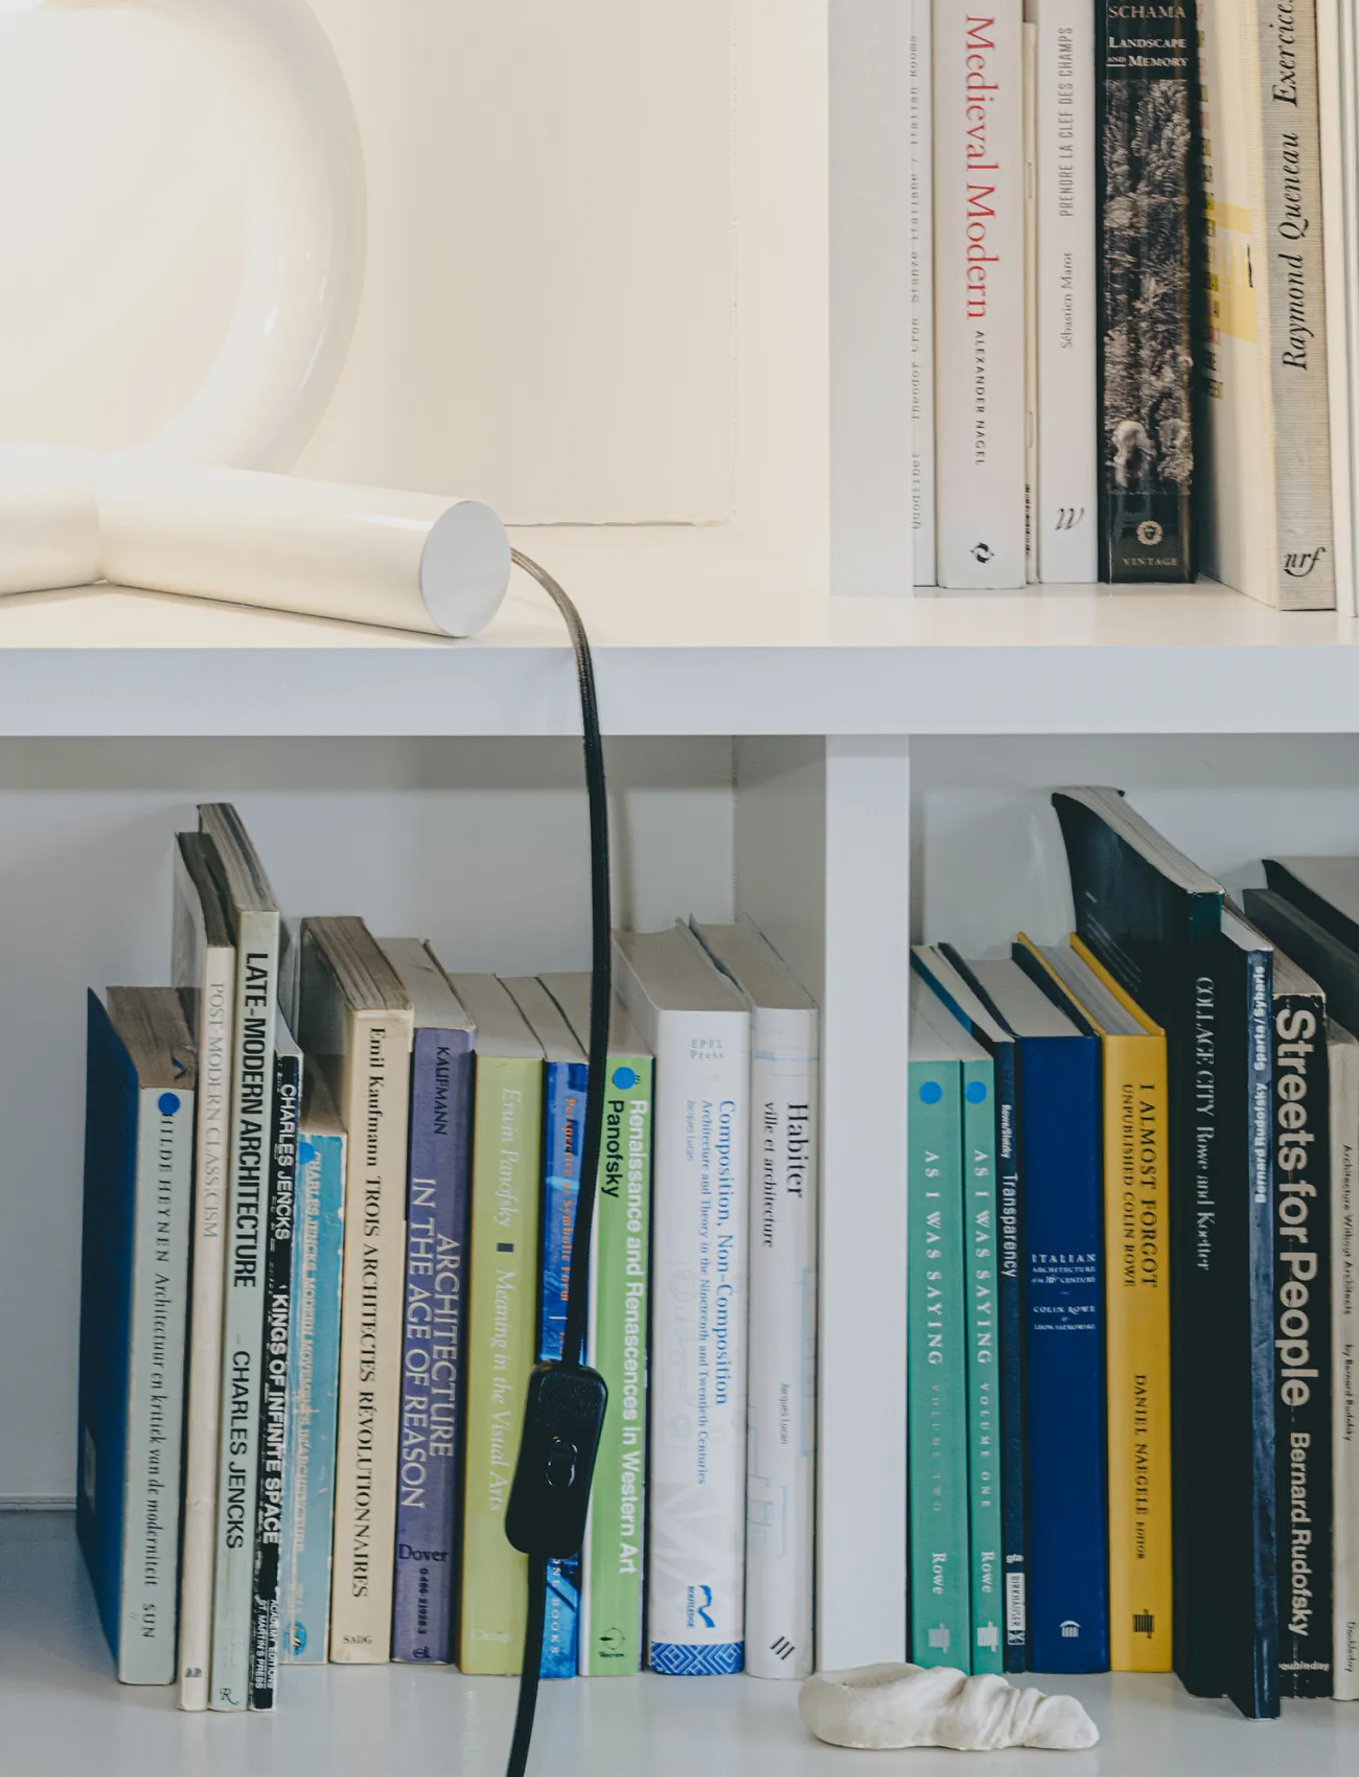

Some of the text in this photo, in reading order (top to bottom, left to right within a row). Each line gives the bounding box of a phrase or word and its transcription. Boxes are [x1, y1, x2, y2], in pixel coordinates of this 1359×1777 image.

[1108, 6, 1188, 19] SCHAMA
[965, 14, 1000, 320] Medieval Modern
[1278, 133, 1311, 369] Raymond Queneau
[976, 330, 985, 466] ALEXANDER NAGEL
[233, 953, 268, 1288] LATE-MODERN ARCHITECTURE
[601, 1100, 625, 1198] Panofsky
[626, 1100, 648, 1233] Renaissance
[714, 1100, 735, 1227] Composition,
[786, 1103, 809, 1198] Habiter
[1122, 1084, 1135, 1288] UNPUBLISHED COLIN ROWE
[1195, 976, 1216, 1271] COLLAGE CITY Rowe and Koetter
[626, 1238, 645, 1275] and
[1001, 1173, 1019, 1277] Transparency
[1274, 1008, 1319, 1407] Streets for People
[151, 1274, 170, 1368] Architectuur
[352, 1176, 381, 1598] TROIS ARCHITECTES RÉVOLUTIONNAIRES
[401, 1178, 436, 1508] IN THE AGE OF REASON
[428, 1235, 461, 1457] ARCHITECTURE
[623, 1282, 644, 1419] Renascences
[148, 1394, 167, 1443] kritiek
[226, 1350, 251, 1549] CHARLES JENCKS
[262, 1294, 288, 1544] KINGS OF INFINITE SPACE
[398, 1543, 448, 1562] Dover
[619, 1543, 637, 1574] Art
[620, 1451, 639, 1537] Western
